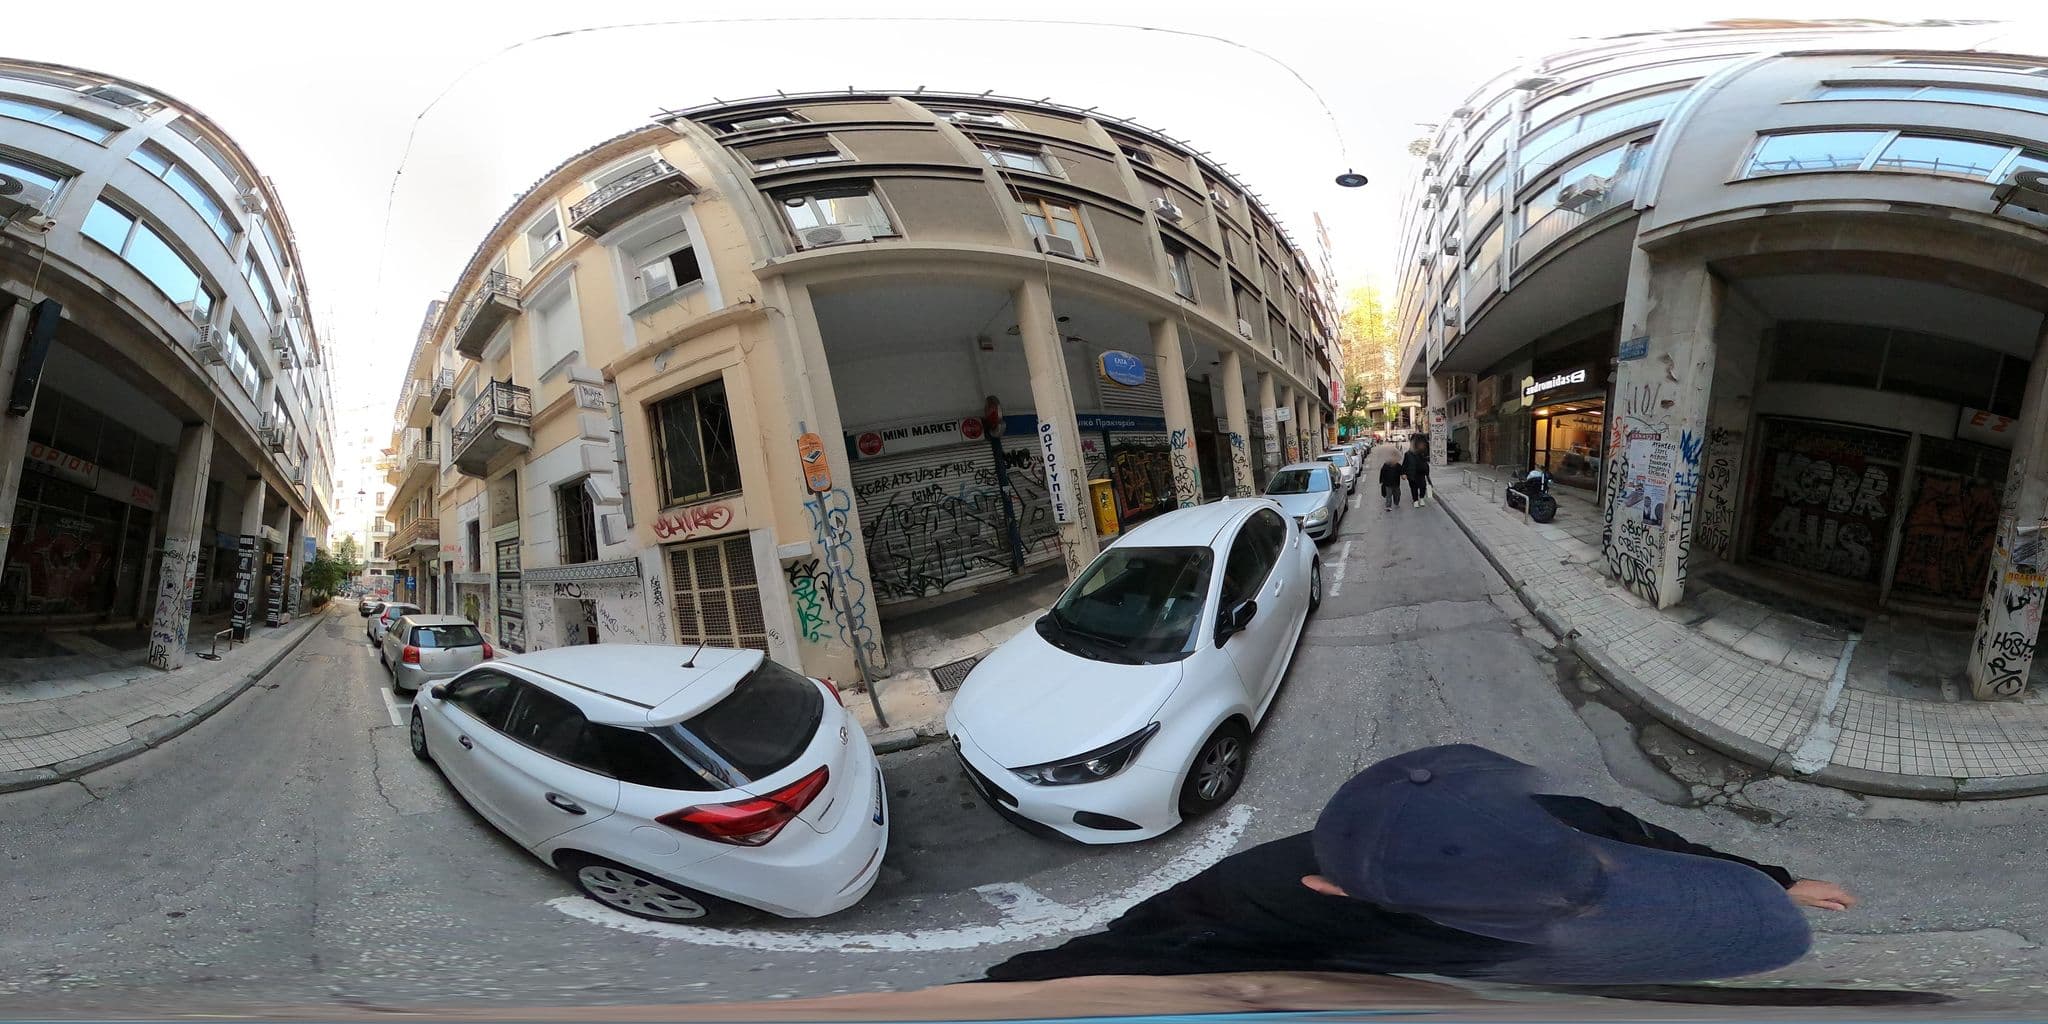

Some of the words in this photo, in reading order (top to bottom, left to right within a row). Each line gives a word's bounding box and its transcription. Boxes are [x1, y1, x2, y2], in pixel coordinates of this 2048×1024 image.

[883, 428, 909, 442] MINI
[911, 421, 958, 437] MARKET
[1040, 423, 1066, 522] ΦΩΤΟΤΥΠΙΕΣ
